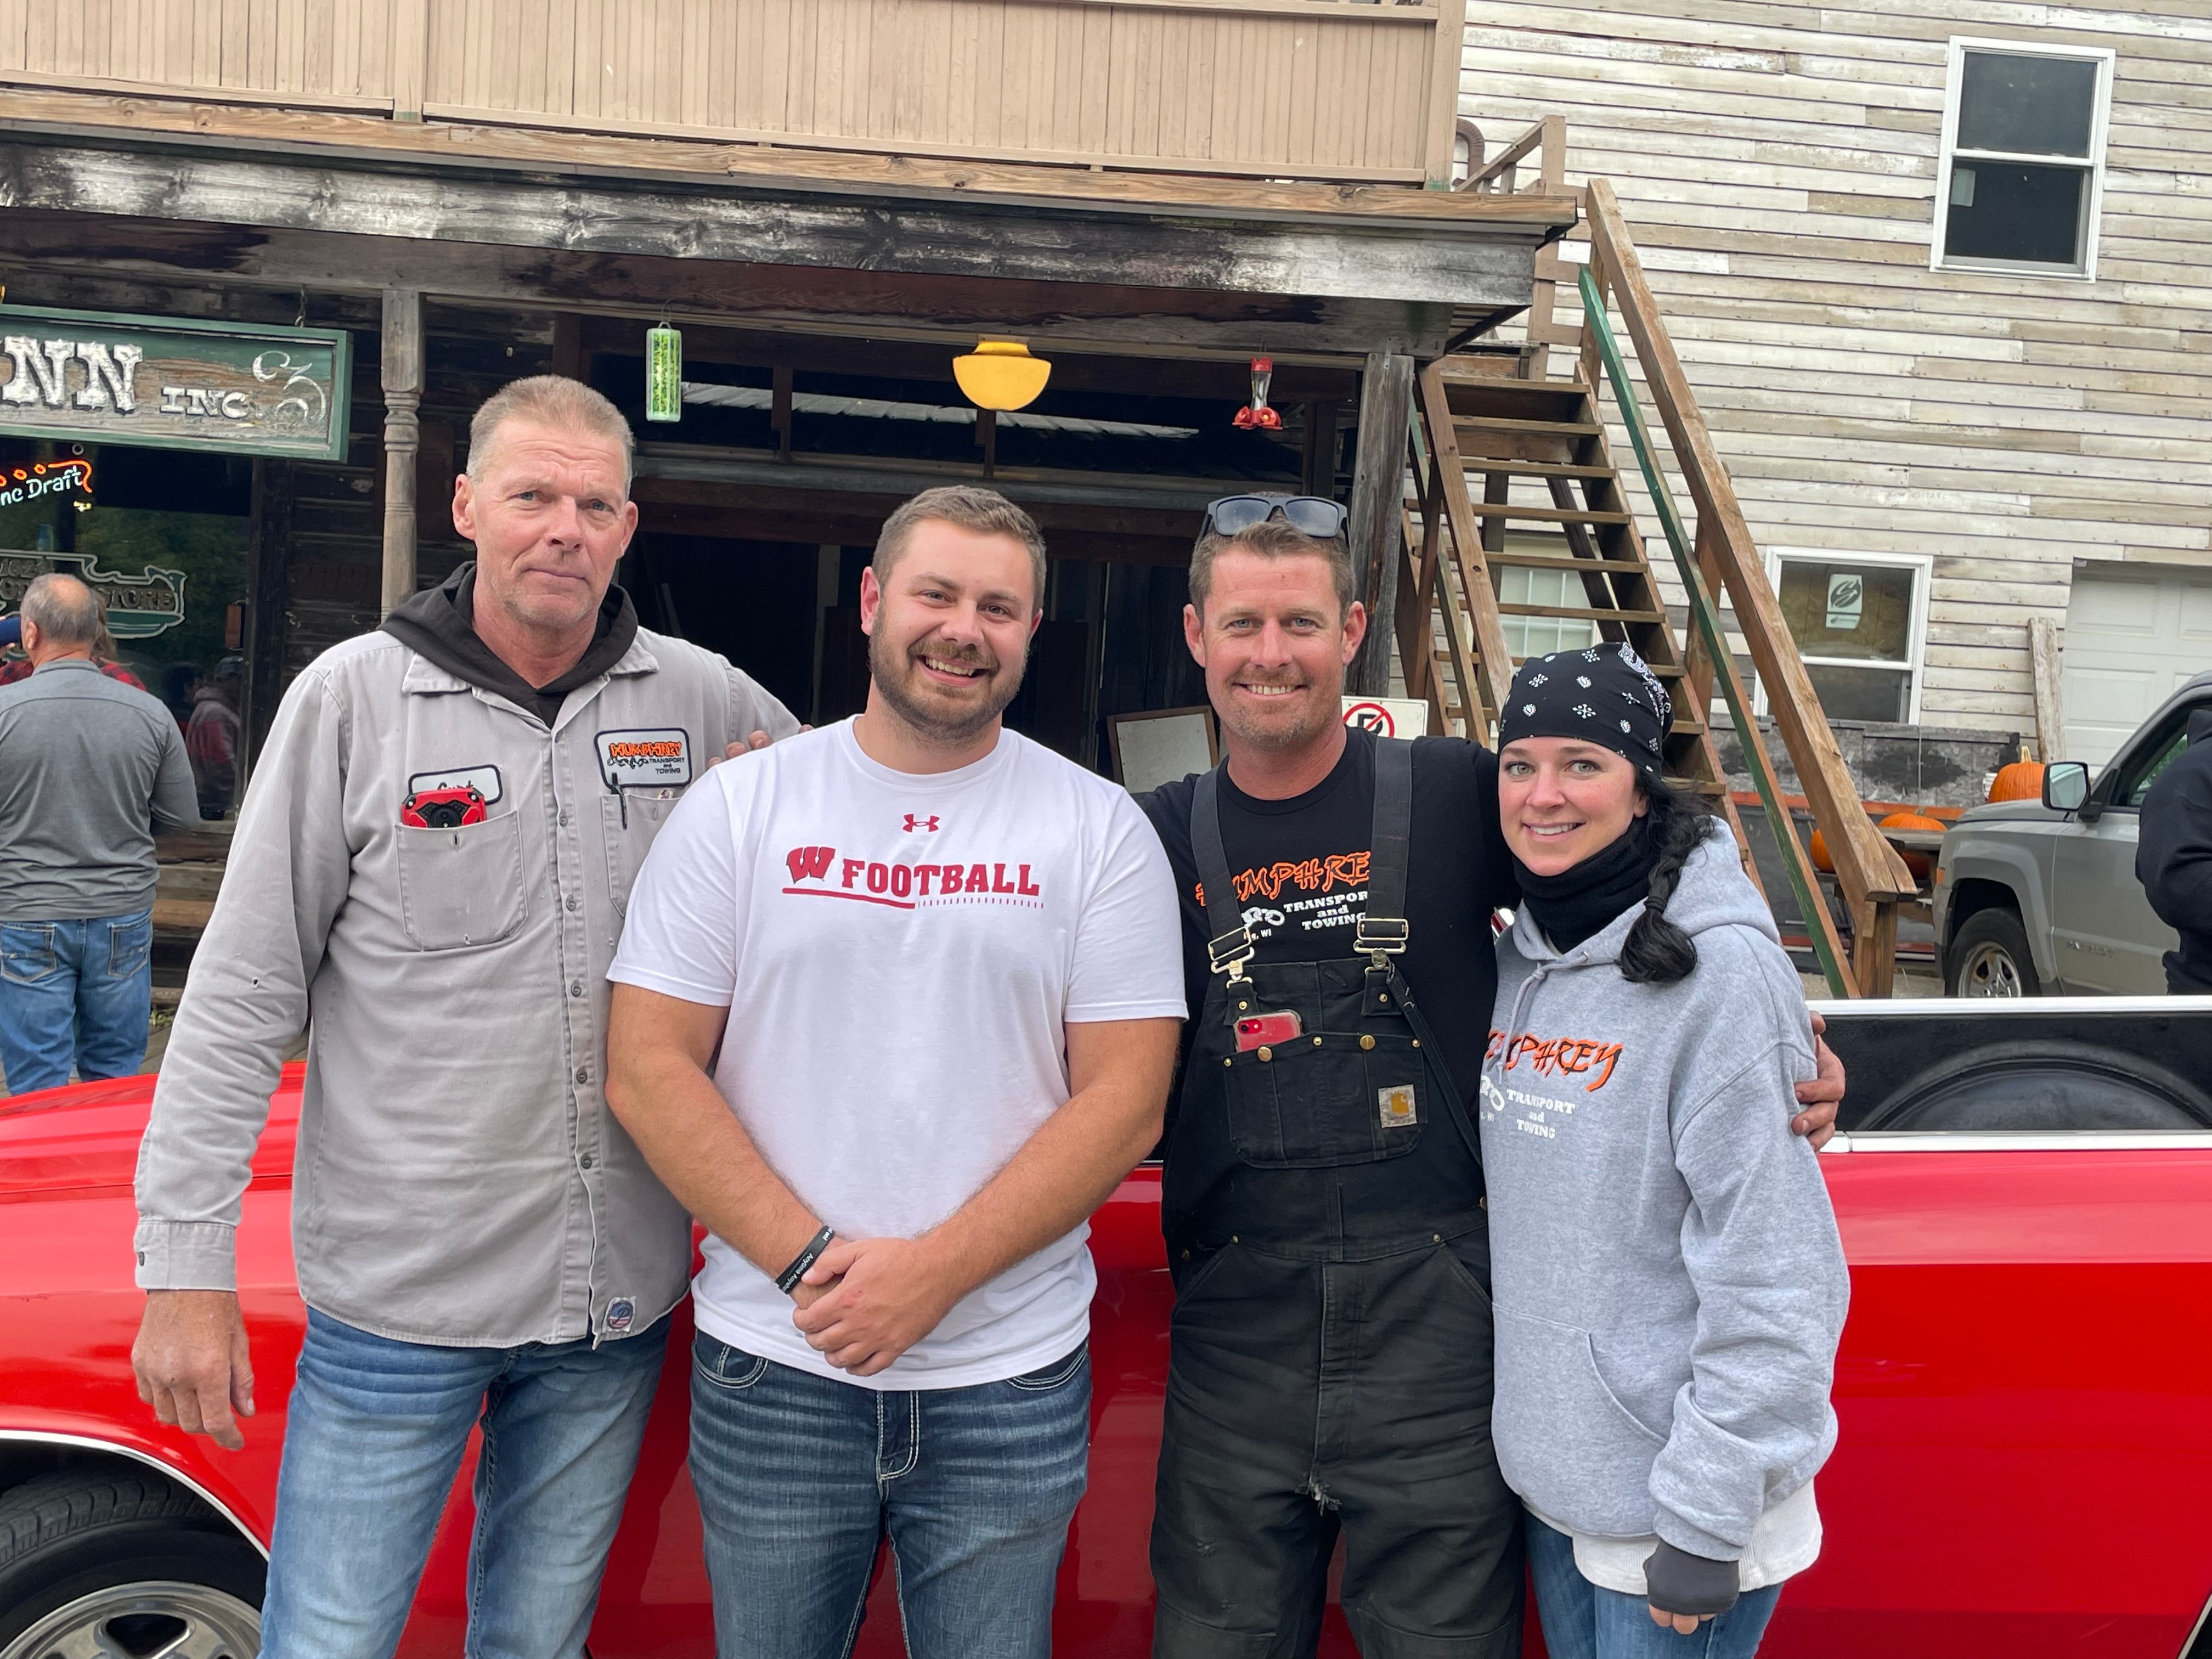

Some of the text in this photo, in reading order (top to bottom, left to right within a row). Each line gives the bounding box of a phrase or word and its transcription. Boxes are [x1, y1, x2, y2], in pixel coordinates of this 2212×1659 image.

[1, 335, 143, 413] NN
[26, 465, 83, 499] Draft
[786, 847, 1040, 898] W FOOTBALL
[1195, 850, 1372, 907] MPHRE
[1283, 891, 1368, 913] TRANSPOR
[1317, 905, 1349, 918] and
[1261, 928, 1272, 938] WI
[1486, 1030, 1623, 1092] PHREY
[1506, 1088, 1576, 1114] TRANSPORT
[1516, 1119, 1555, 1139] TOWING
[1528, 1111, 1545, 1122] and
